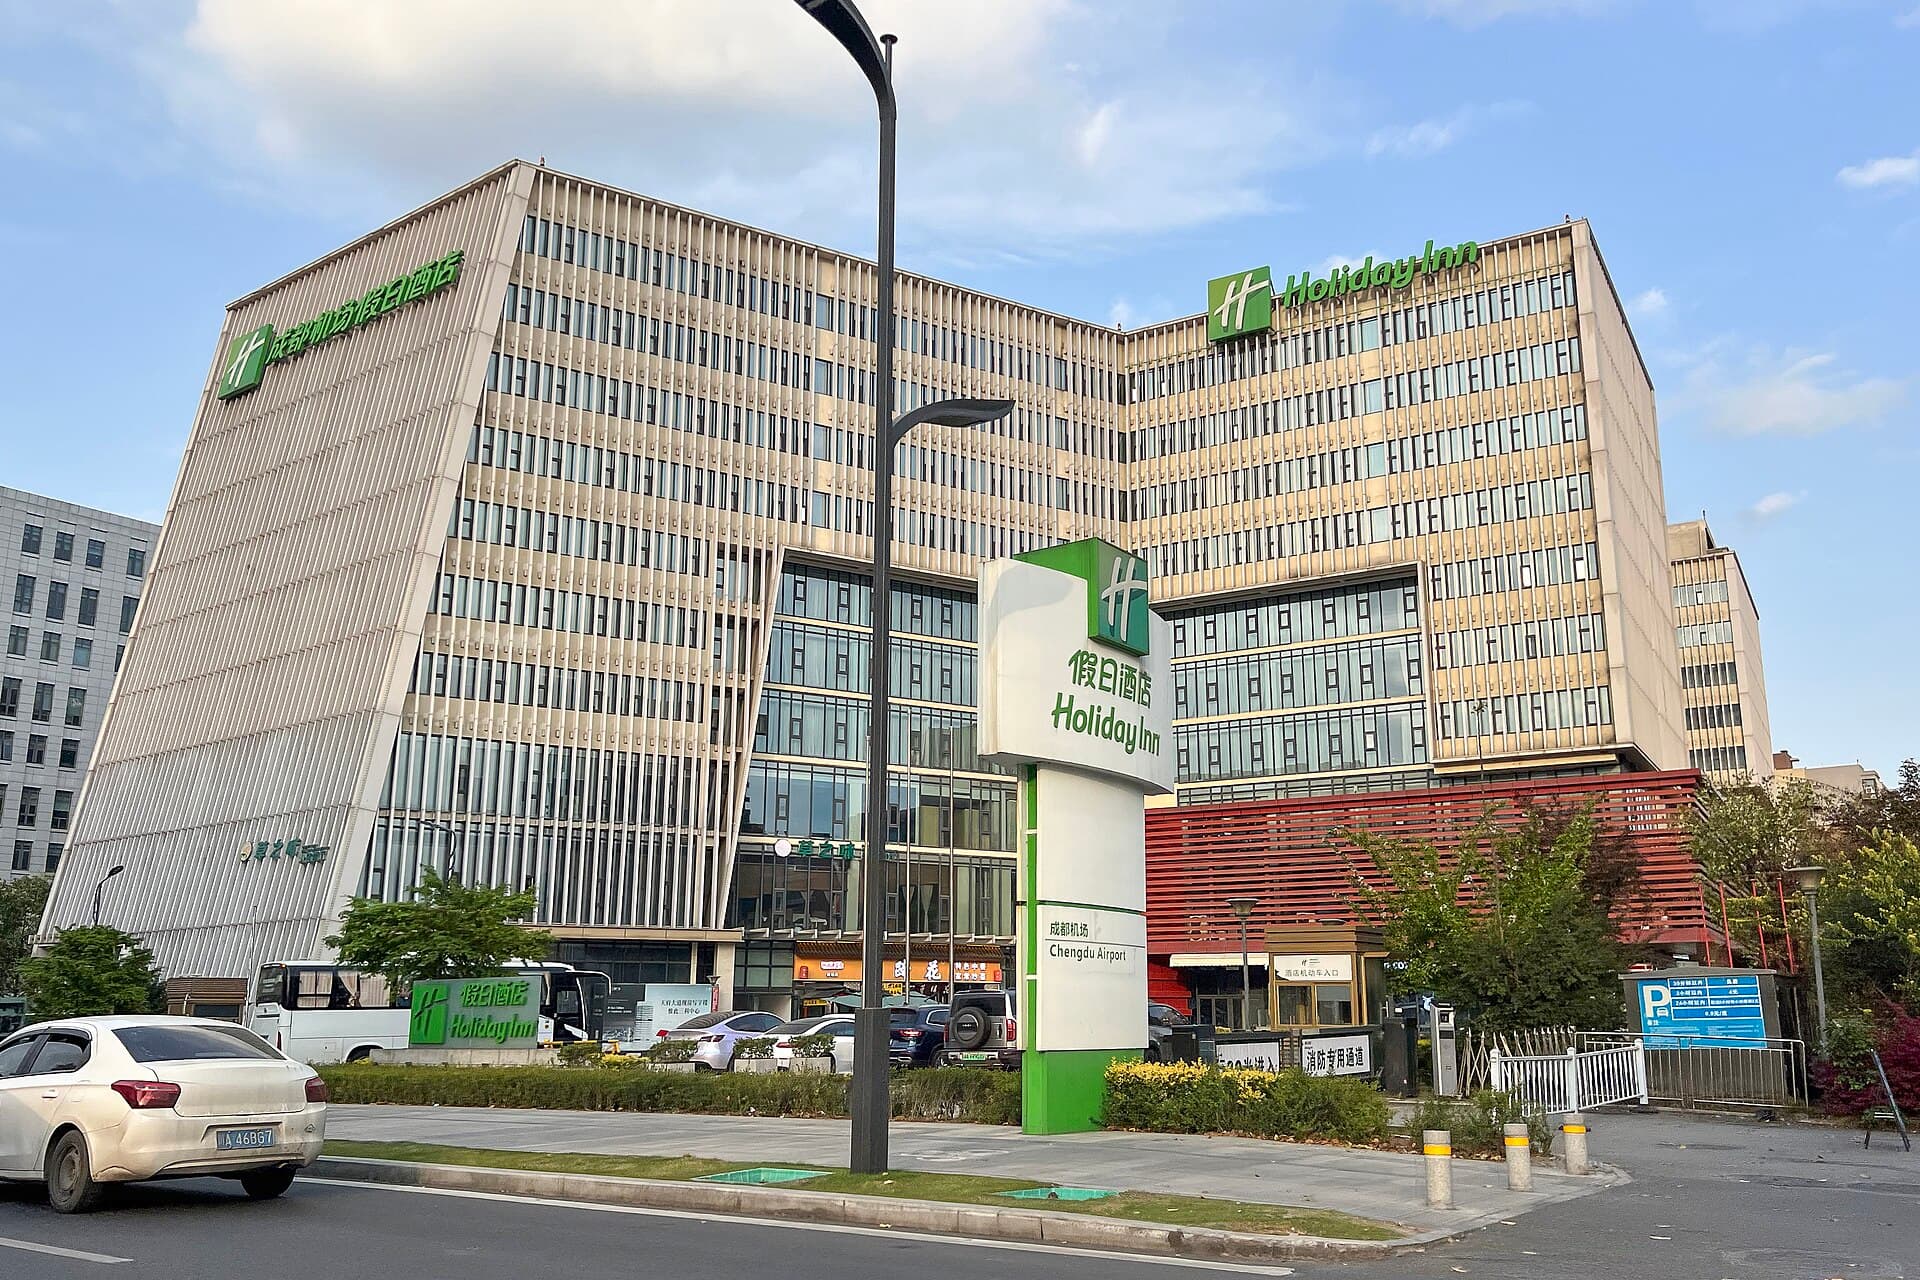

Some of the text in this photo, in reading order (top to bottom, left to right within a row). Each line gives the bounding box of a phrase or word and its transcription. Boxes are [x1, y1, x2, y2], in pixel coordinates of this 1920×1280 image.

[1282, 255, 1416, 309] Holiday
[1421, 239, 1477, 273] Inn
[267, 249, 464, 365] 成都机场假日酒店
[1067, 648, 1152, 709] 假日酒店
[1051, 691, 1161, 756] Holiday Inn
[1049, 921, 1089, 938] 成都机场
[1049, 944, 1126, 963] Chengdu Airport
[460, 980, 530, 1008] 假日酒店
[1643, 985, 1670, 1018] P
[449, 1013, 537, 1044] Holiday Inn
[1305, 1047, 1364, 1073] 消防专用通道
[235, 1129, 272, 1146] 46BG7
